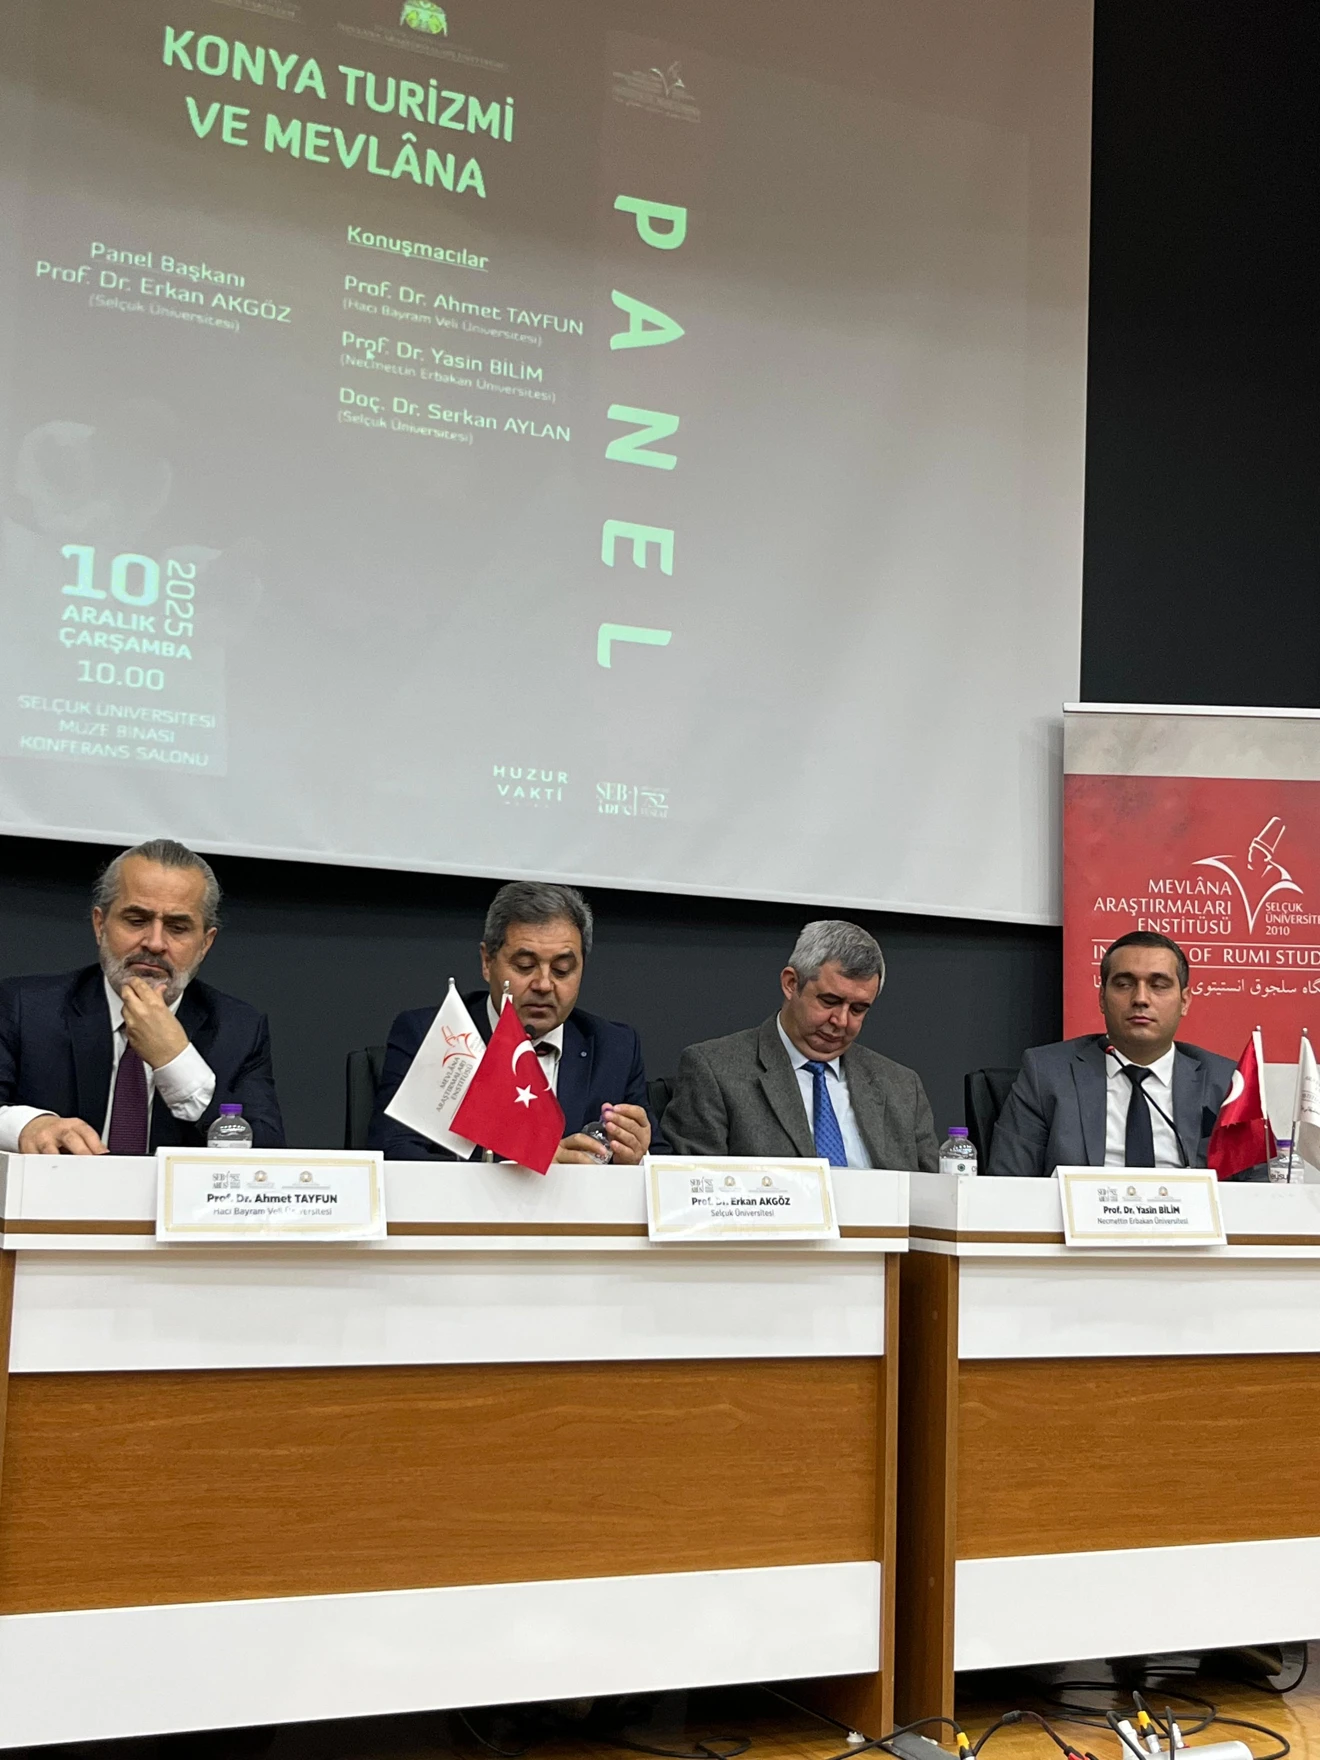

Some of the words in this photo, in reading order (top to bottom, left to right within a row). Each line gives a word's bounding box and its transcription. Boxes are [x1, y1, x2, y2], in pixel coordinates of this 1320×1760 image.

[163, 25, 327, 100] KONYA
[338, 65, 514, 142] TURİZMİ
[186, 96, 250, 146] VE
[264, 113, 486, 198] MEVLÂNA
[347, 225, 489, 269] Konuşmacılar
[90, 241, 152, 269] Panel
[161, 255, 245, 288] Başkanı
[36, 261, 90, 285] Prof.
[100, 271, 131, 291] Dr.
[140, 277, 204, 306] Erkan
[211, 292, 292, 323] AKGÖZ
[344, 275, 392, 299] Prof.
[399, 286, 427, 306] Dr.
[434, 294, 502, 321] Ahmet
[507, 307, 583, 336] TAYFUN
[381, 305, 431, 324] Bayram
[435, 315, 458, 329] Veli
[342, 331, 389, 355] Prof.
[397, 342, 424, 362] Dr.
[431, 348, 482, 372] Yasin
[490, 358, 543, 382] BİLİM
[420, 368, 472, 388] Erbakan
[339, 387, 385, 413] Doç.
[393, 397, 420, 417] Dr.
[428, 404, 497, 429] Serkan
[504, 418, 571, 442] AYLAN
[597, 195, 687, 668] PANEL
[61, 544, 160, 606] 10
[164, 559, 196, 637] 2025
[61, 604, 156, 633] ARALIK
[59, 627, 192, 660] ÇARŞAMBA
[77, 660, 164, 690] 10.00
[17, 695, 92, 716] SELÇUK
[20, 735, 130, 759] KONFERANS
[135, 746, 209, 767] SALONU
[493, 765, 568, 784] HUZUR
[497, 784, 562, 802] VAKTİ
[1149, 877, 1232, 895] MEVLÂNA
[1094, 897, 1231, 916] ARAŞTIRMALARI
[1265, 902, 1303, 914] SELÇUK
[1138, 916, 1231, 934] ENSTİTÜSÜ
[1265, 925, 1290, 936] 2010
[1189, 948, 1211, 962] OF
[1224, 949, 1269, 964] RUMI
[1250, 980, 1297, 998] سلجوق
[207, 1193, 233, 1203] Prof.
[236, 1194, 252, 1203] Dr.
[255, 1193, 292, 1203] Ahmet
[295, 1194, 337, 1203] TAYFUN
[691, 1197, 714, 1206] Prof.
[731, 1197, 757, 1206] Erkan
[759, 1195, 791, 1206] AKGÖZ
[234, 1208, 265, 1216] Bayram
[711, 1209, 733, 1217] Selçuk
[735, 1208, 774, 1217] Üniversitesi
[1103, 1206, 1122, 1214] Prof.
[1124, 1206, 1135, 1214] Dr.
[1136, 1206, 1157, 1214] Yasin
[1159, 1204, 1180, 1214] BİLİM
[1097, 1217, 1128, 1225] Necmettin
[1129, 1217, 1153, 1225] Erbakan
